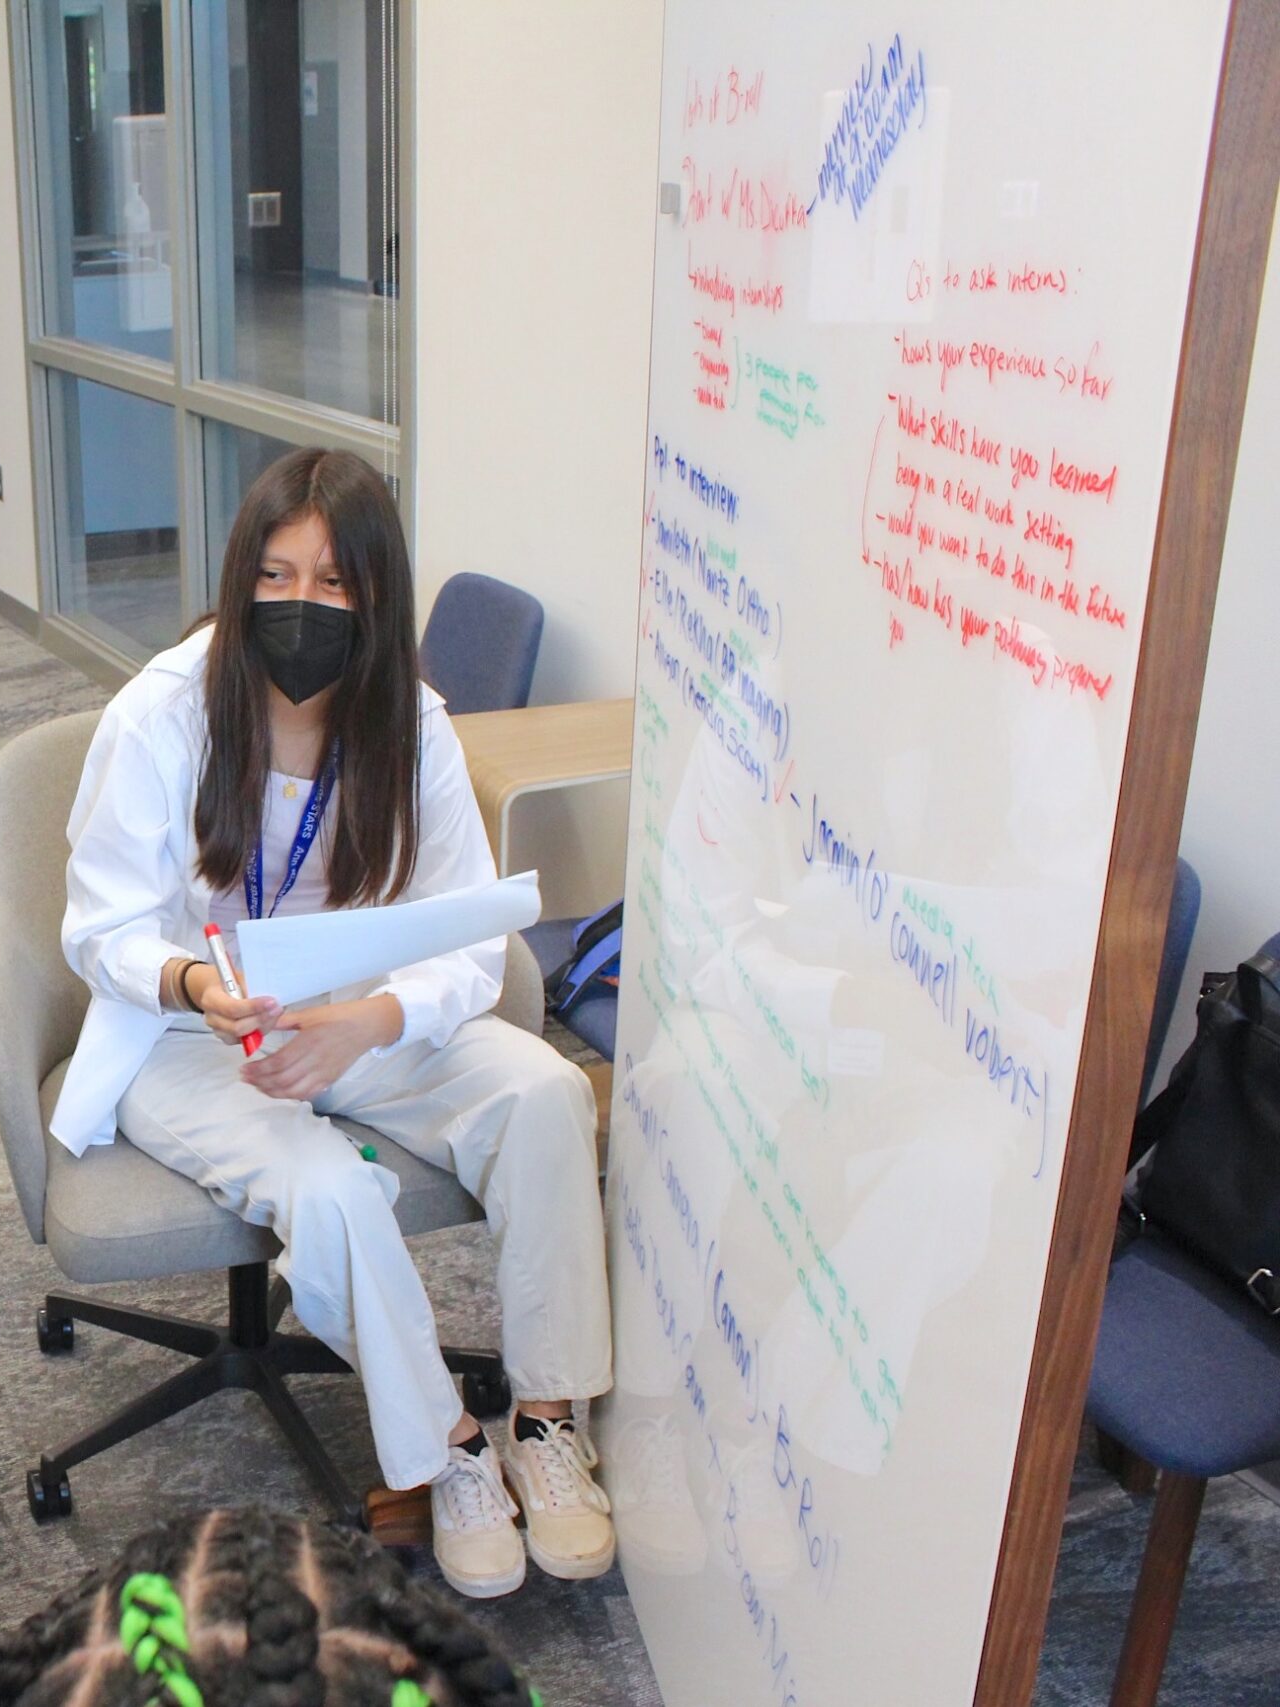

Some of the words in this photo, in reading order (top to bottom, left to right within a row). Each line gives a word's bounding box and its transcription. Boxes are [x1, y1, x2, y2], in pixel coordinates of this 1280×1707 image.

[944, 255, 960, 289] to
[969, 262, 997, 291] ask
[937, 339, 965, 393] your
[969, 341, 1046, 384] experience
[1080, 341, 1115, 401] far
[675, 452, 687, 481] to
[930, 410, 966, 455] skills
[971, 425, 1001, 466] have
[1010, 447, 1039, 489] you
[1050, 447, 1118, 504] learned
[895, 452, 921, 510] being
[925, 472, 936, 495] in
[943, 479, 951, 506] a
[956, 479, 981, 514] real
[985, 498, 1015, 525] work
[1023, 510, 1074, 569] setting
[887, 508, 914, 537] would
[918, 520, 935, 554] you
[939, 530, 968, 562] want
[976, 536, 989, 569] to
[990, 545, 1006, 578] do
[1011, 553, 1036, 595] this
[1041, 576, 1054, 602] in
[1058, 579, 1079, 616] the
[933, 578, 953, 630] has
[960, 606, 990, 648] your
[1051, 654, 1113, 701] prepared
[301, 803, 320, 840] STARS
[291, 845, 306, 867] Ann
